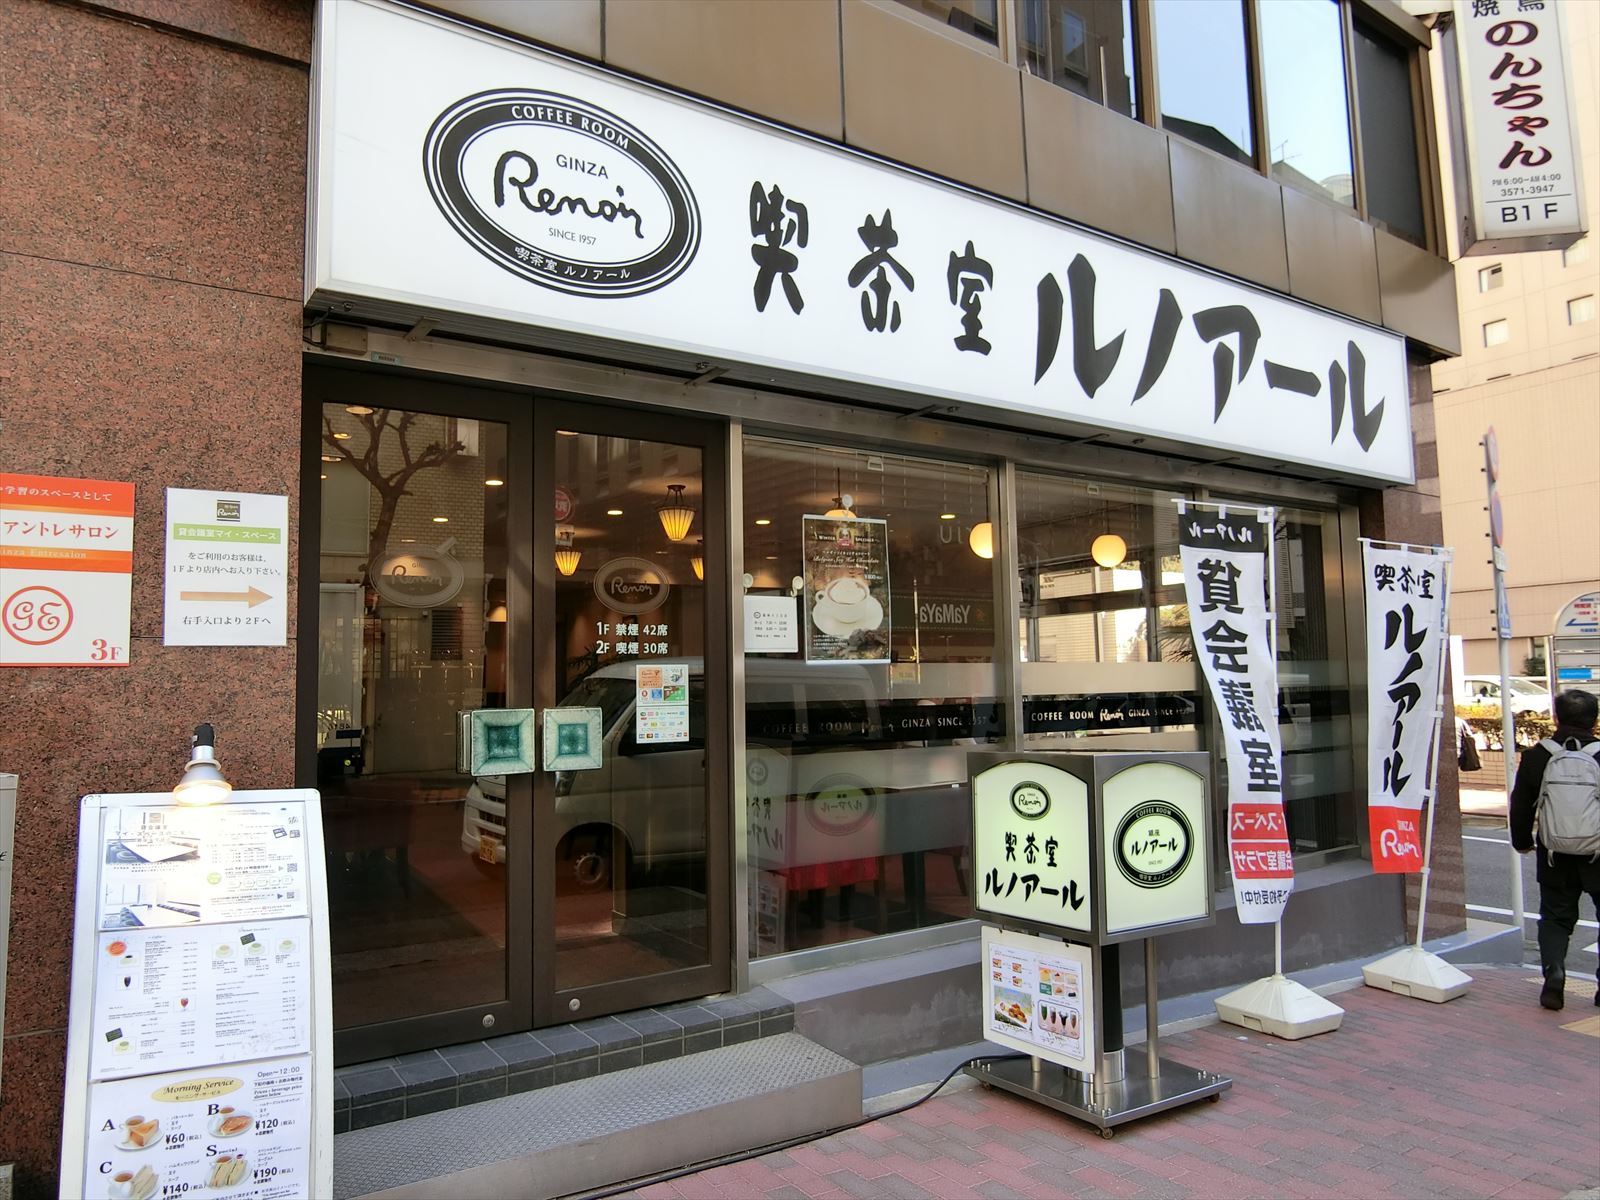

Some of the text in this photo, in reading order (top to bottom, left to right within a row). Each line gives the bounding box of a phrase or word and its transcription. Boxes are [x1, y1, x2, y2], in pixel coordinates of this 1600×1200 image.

[1485, 20, 1553, 169] のんちゃん
[511, 105, 630, 150] COFFEE ROOM
[555, 154, 609, 179] GINZA
[494, 150, 644, 239] Renoir
[1500, 184, 1554, 197] 3571-3947
[548, 227, 597, 246] SINCE 1957
[514, 246, 631, 280] 喫茶室 ルノアール
[3, 520, 119, 540] アントレサロン
[31, 548, 87, 559] Entresalon
[611, 576, 653, 596] Renoir
[1373, 563, 1436, 600] 喫茶室
[596, 621, 669, 637] 1F 禁煙 42席
[90, 638, 123, 662] 3F
[596, 640, 669, 655] 2F 喫煙 30席
[1383, 602, 1429, 798] ルノアール
[1031, 711, 1063, 722] COFFEE
[1069, 710, 1094, 720] ROOM
[1128, 708, 1151, 718] GINZA
[763, 723, 809, 734] OFFEE
[901, 718, 931, 728] GINZA
[1135, 807, 1172, 819] COFFEE ROOM
[1004, 831, 1059, 868] 喫茶室
[1130, 837, 1179, 856] ルノアール
[984, 867, 1085, 912] ルノアール
[163, 1079, 235, 1095] Morning Service
[207, 1103, 220, 1117] B
[101, 1118, 116, 1133] A
[255, 1118, 279, 1131] ¥120
[165, 1133, 185, 1145] ¥60
[99, 1161, 113, 1174] C
[253, 1167, 278, 1180] ¥190
[163, 1182, 189, 1195] ¥140
